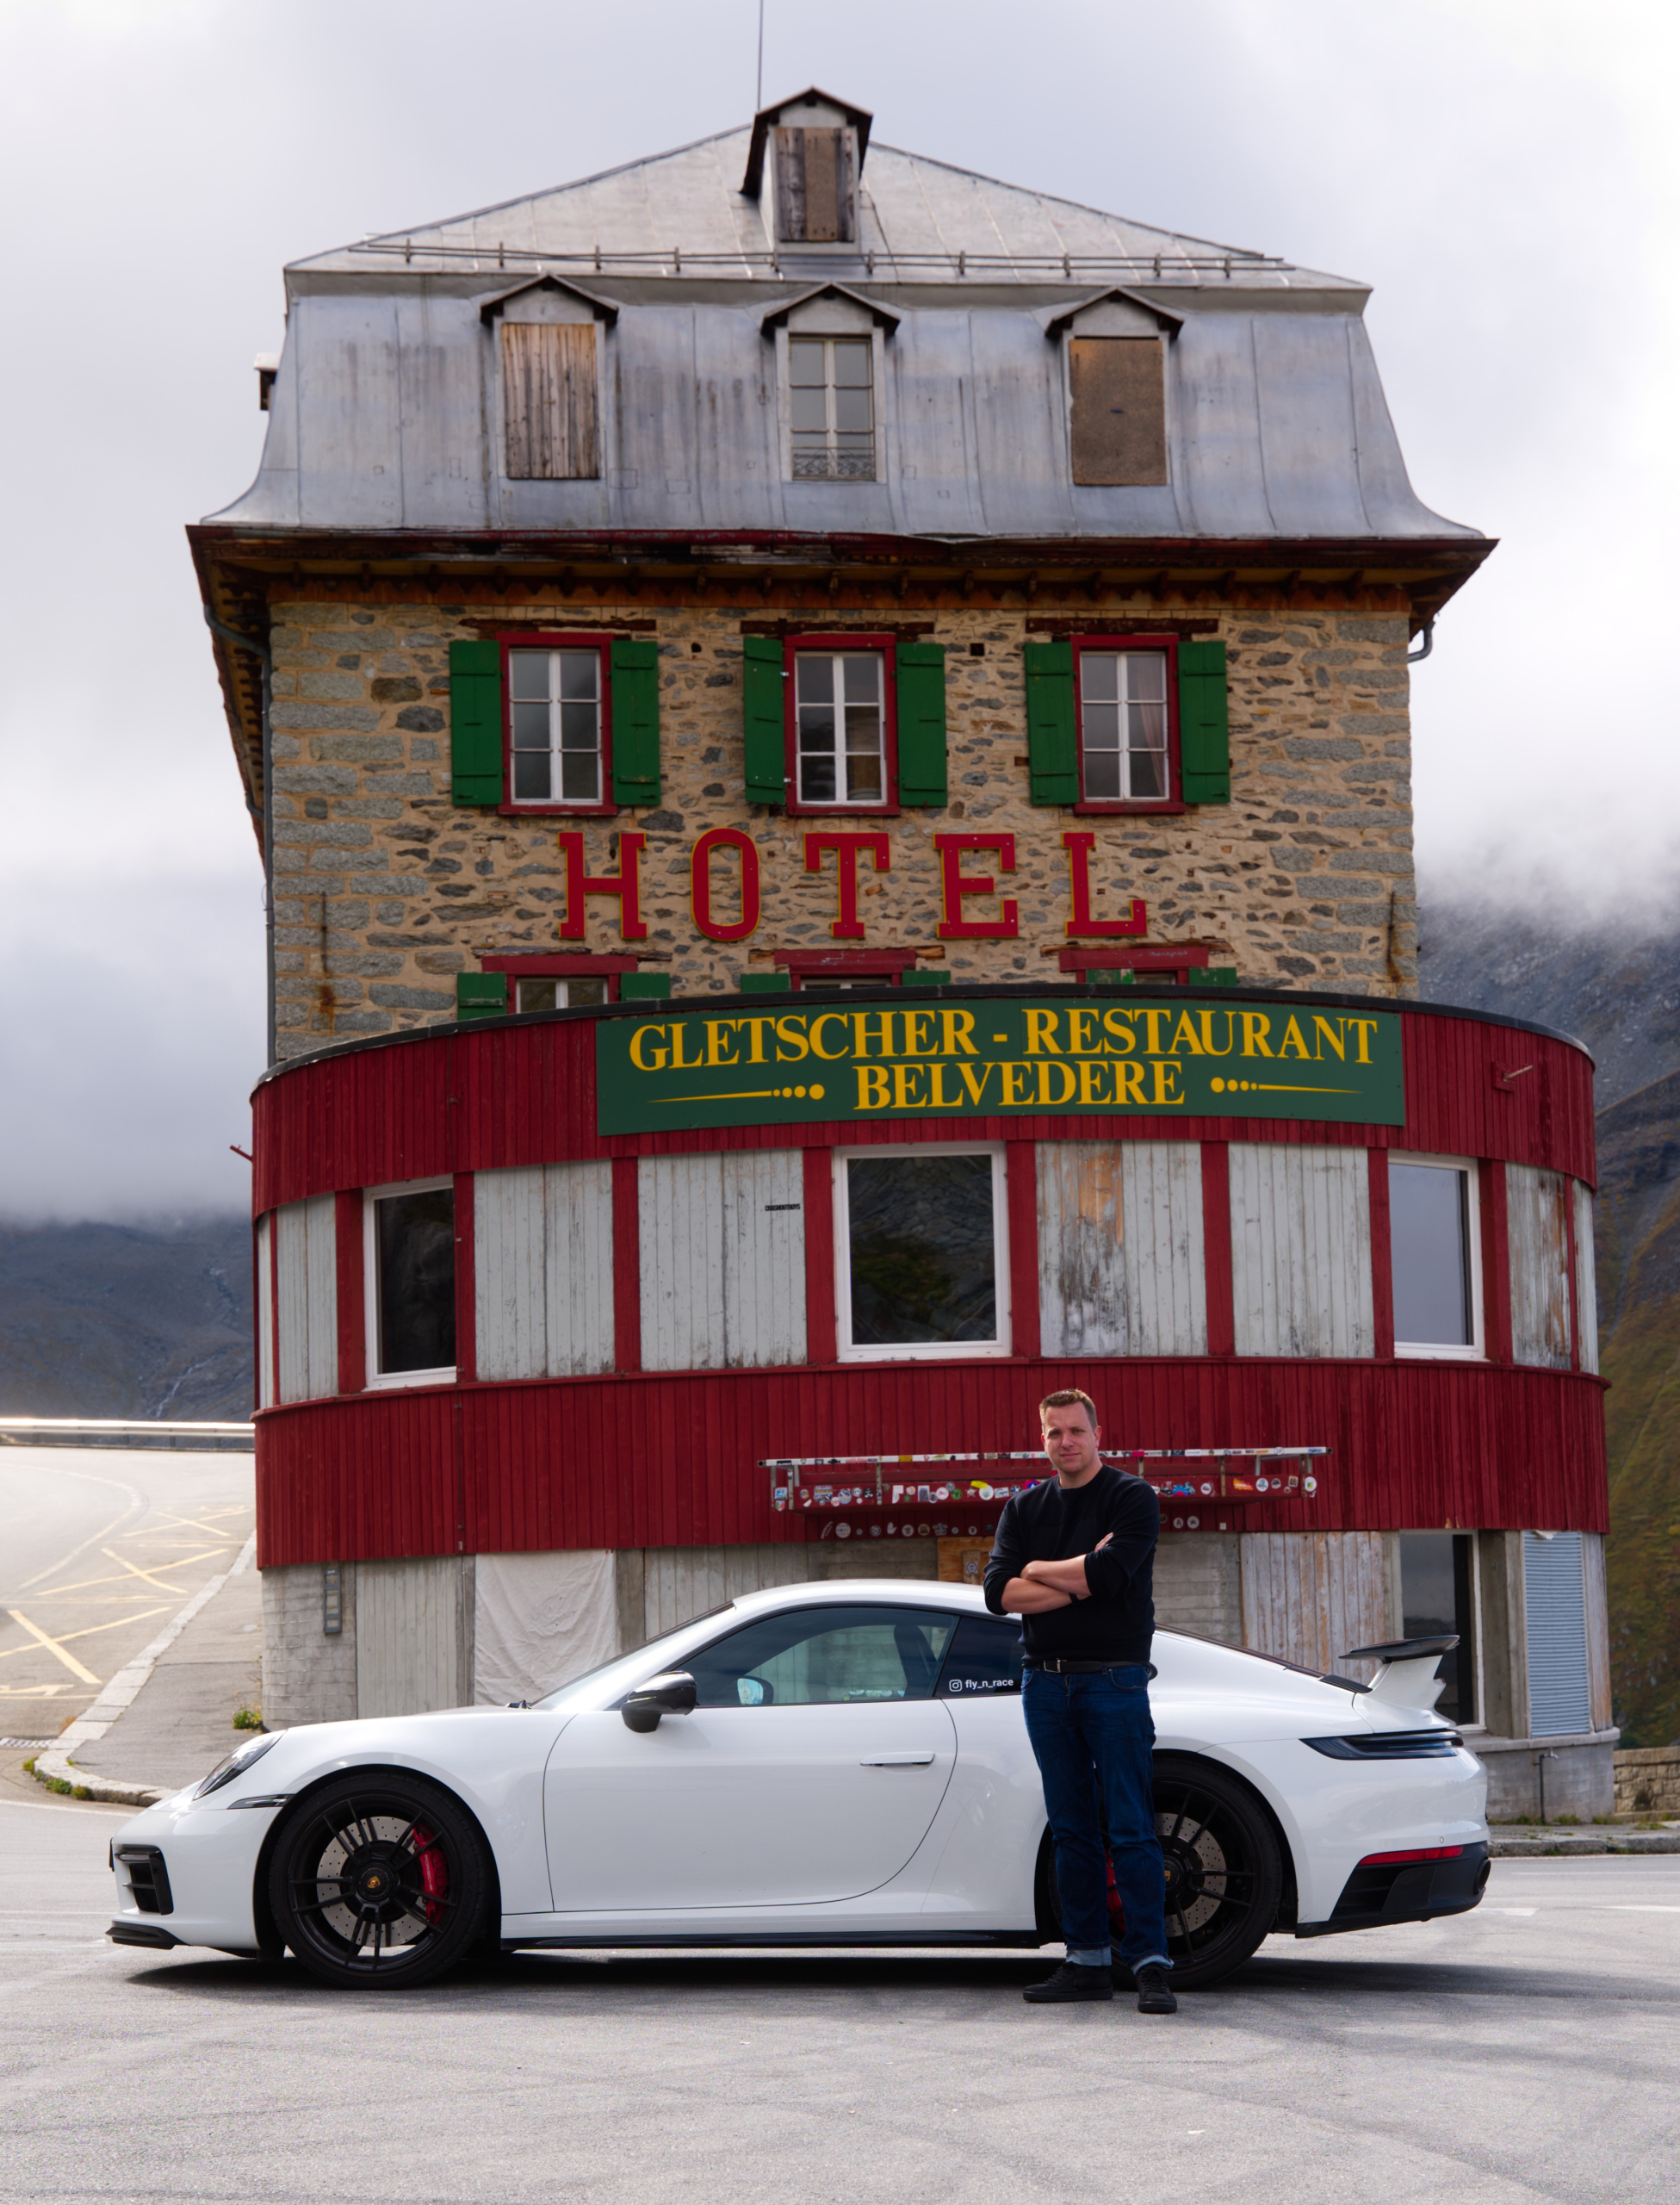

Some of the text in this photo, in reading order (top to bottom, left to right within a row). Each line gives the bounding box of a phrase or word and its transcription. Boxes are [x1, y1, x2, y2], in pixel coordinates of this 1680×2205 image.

[558, 828, 1148, 941] HOTEL
[629, 1009, 981, 1071] GLETSCHER
[1021, 1008, 1378, 1065] RESTAURANT
[852, 1060, 1185, 1109] BELVEDERE
[965, 1679, 1014, 1690] fly_n_race
[425, 1854, 433, 1891] PORSCHE
